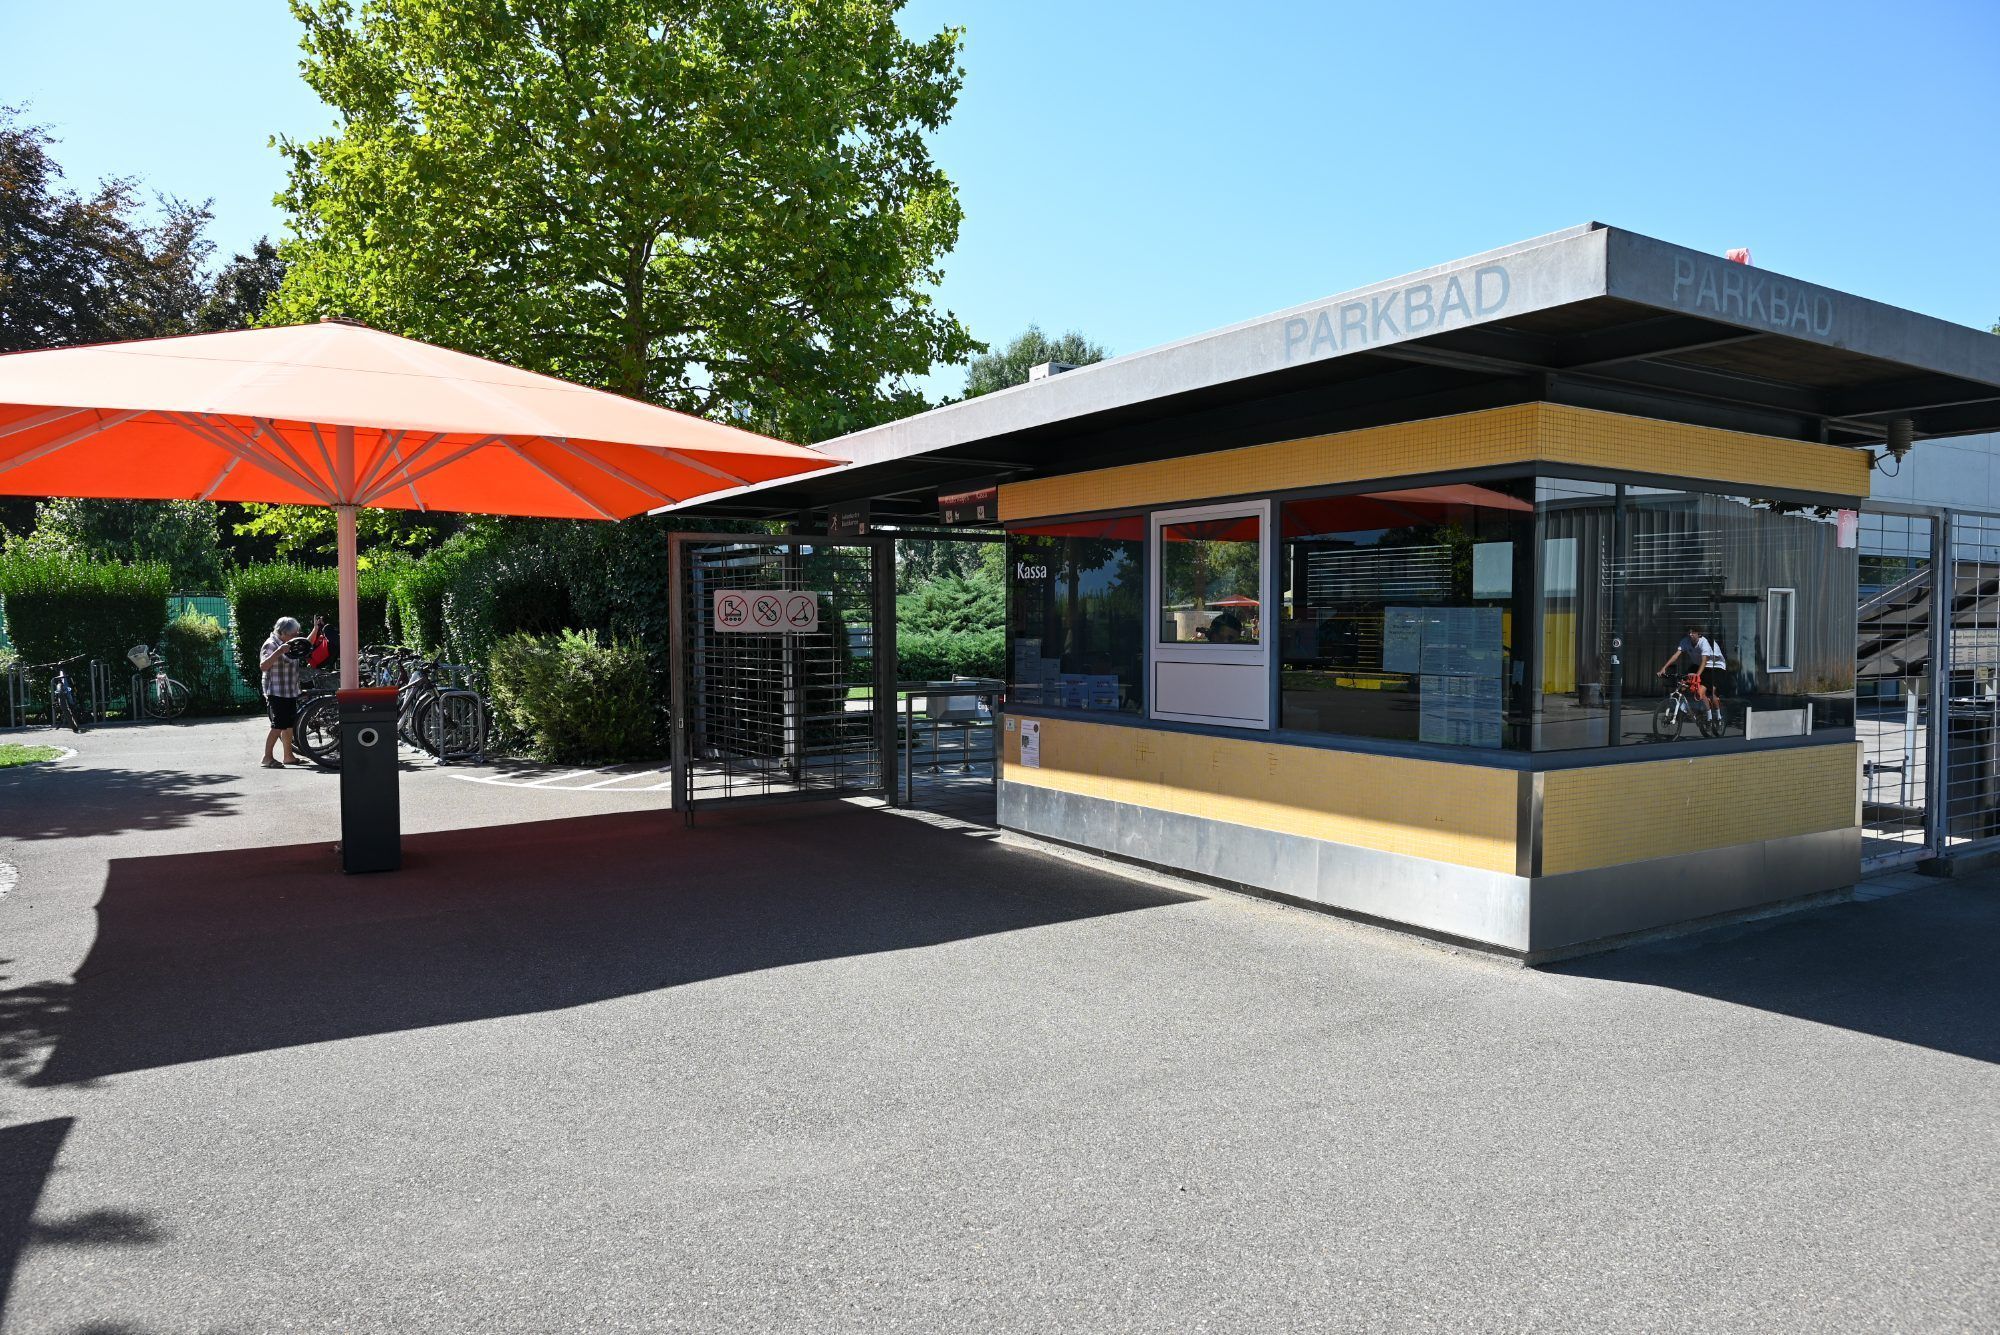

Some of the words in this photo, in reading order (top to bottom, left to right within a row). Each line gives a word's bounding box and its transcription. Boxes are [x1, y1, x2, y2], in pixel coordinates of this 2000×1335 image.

[1284, 265, 1511, 362] PARKBAD
[1672, 254, 1833, 336] PARKBAD
[1017, 562, 1047, 579] Kassa
